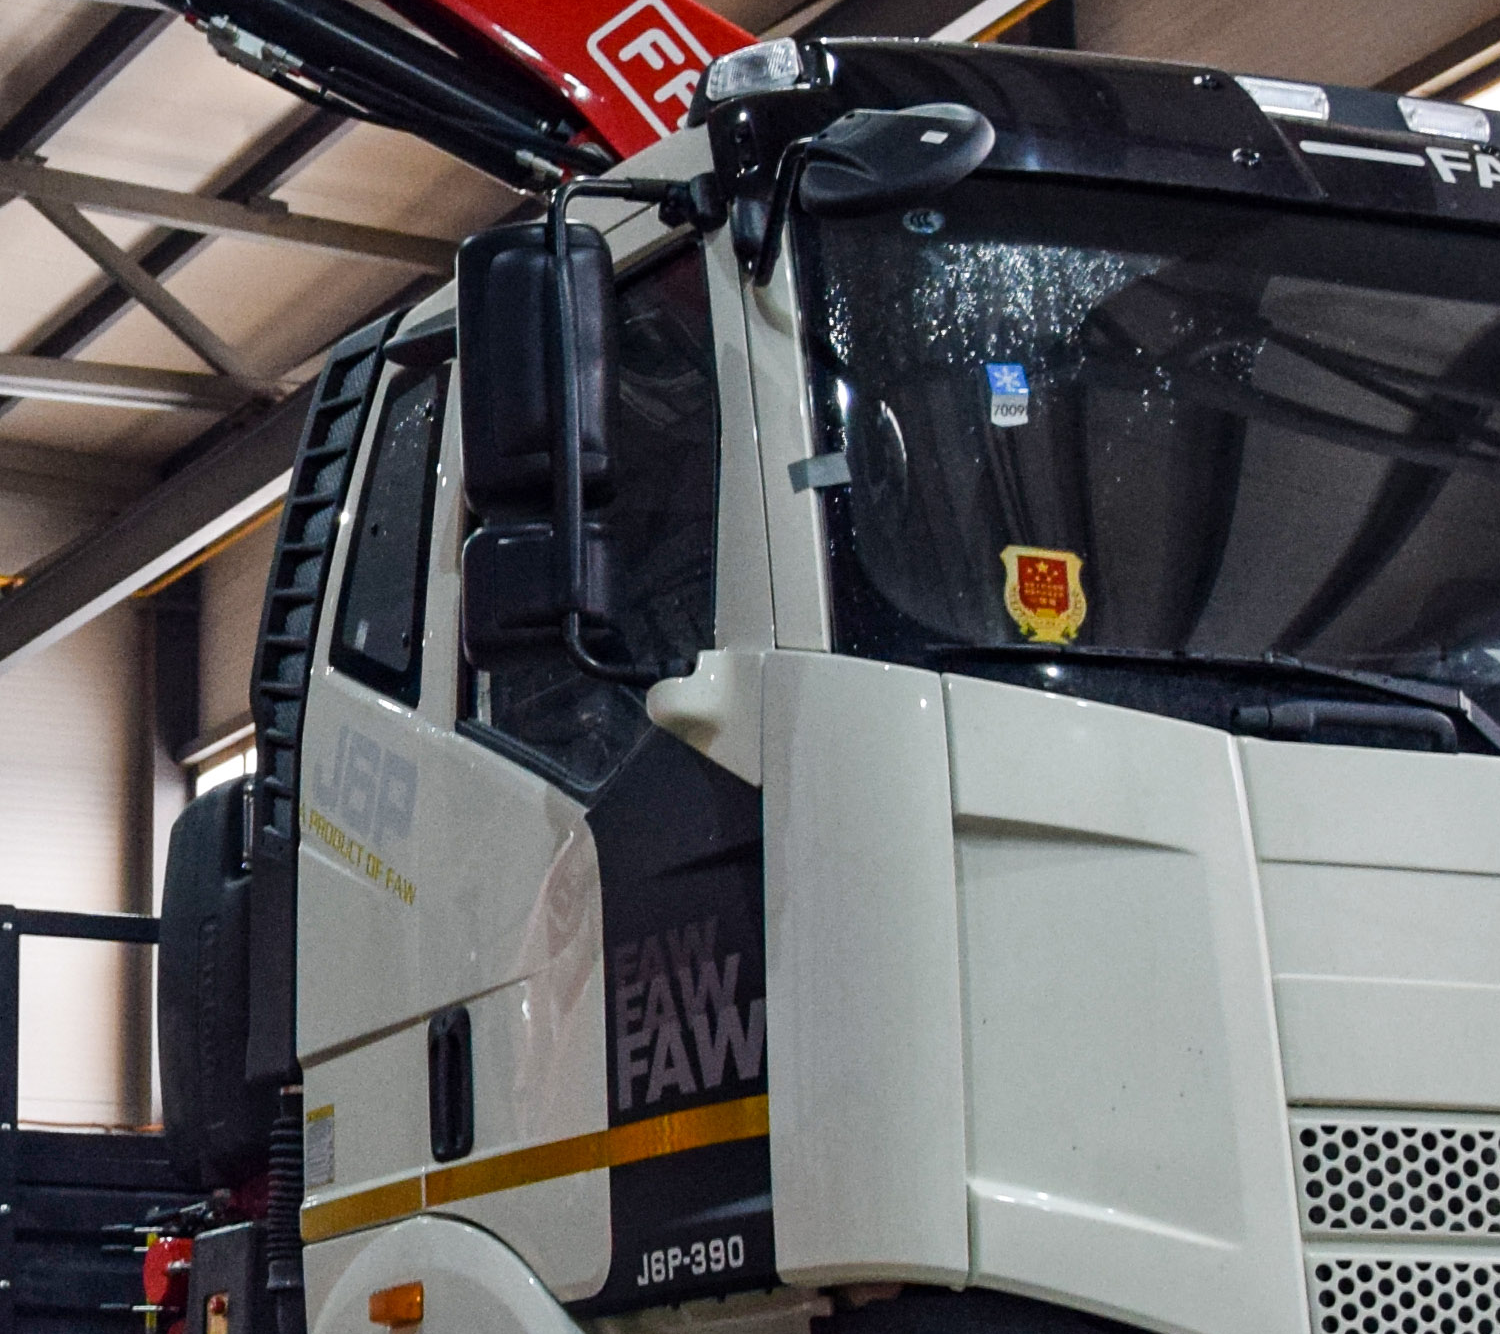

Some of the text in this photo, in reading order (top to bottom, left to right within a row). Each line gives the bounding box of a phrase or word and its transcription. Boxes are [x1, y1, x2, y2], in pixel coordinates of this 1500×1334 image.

[312, 726, 419, 850] J6P
[309, 808, 364, 867] PRODUCT
[366, 852, 384, 881] OF
[385, 867, 418, 907] FAW
[616, 996, 768, 1112] FAW
